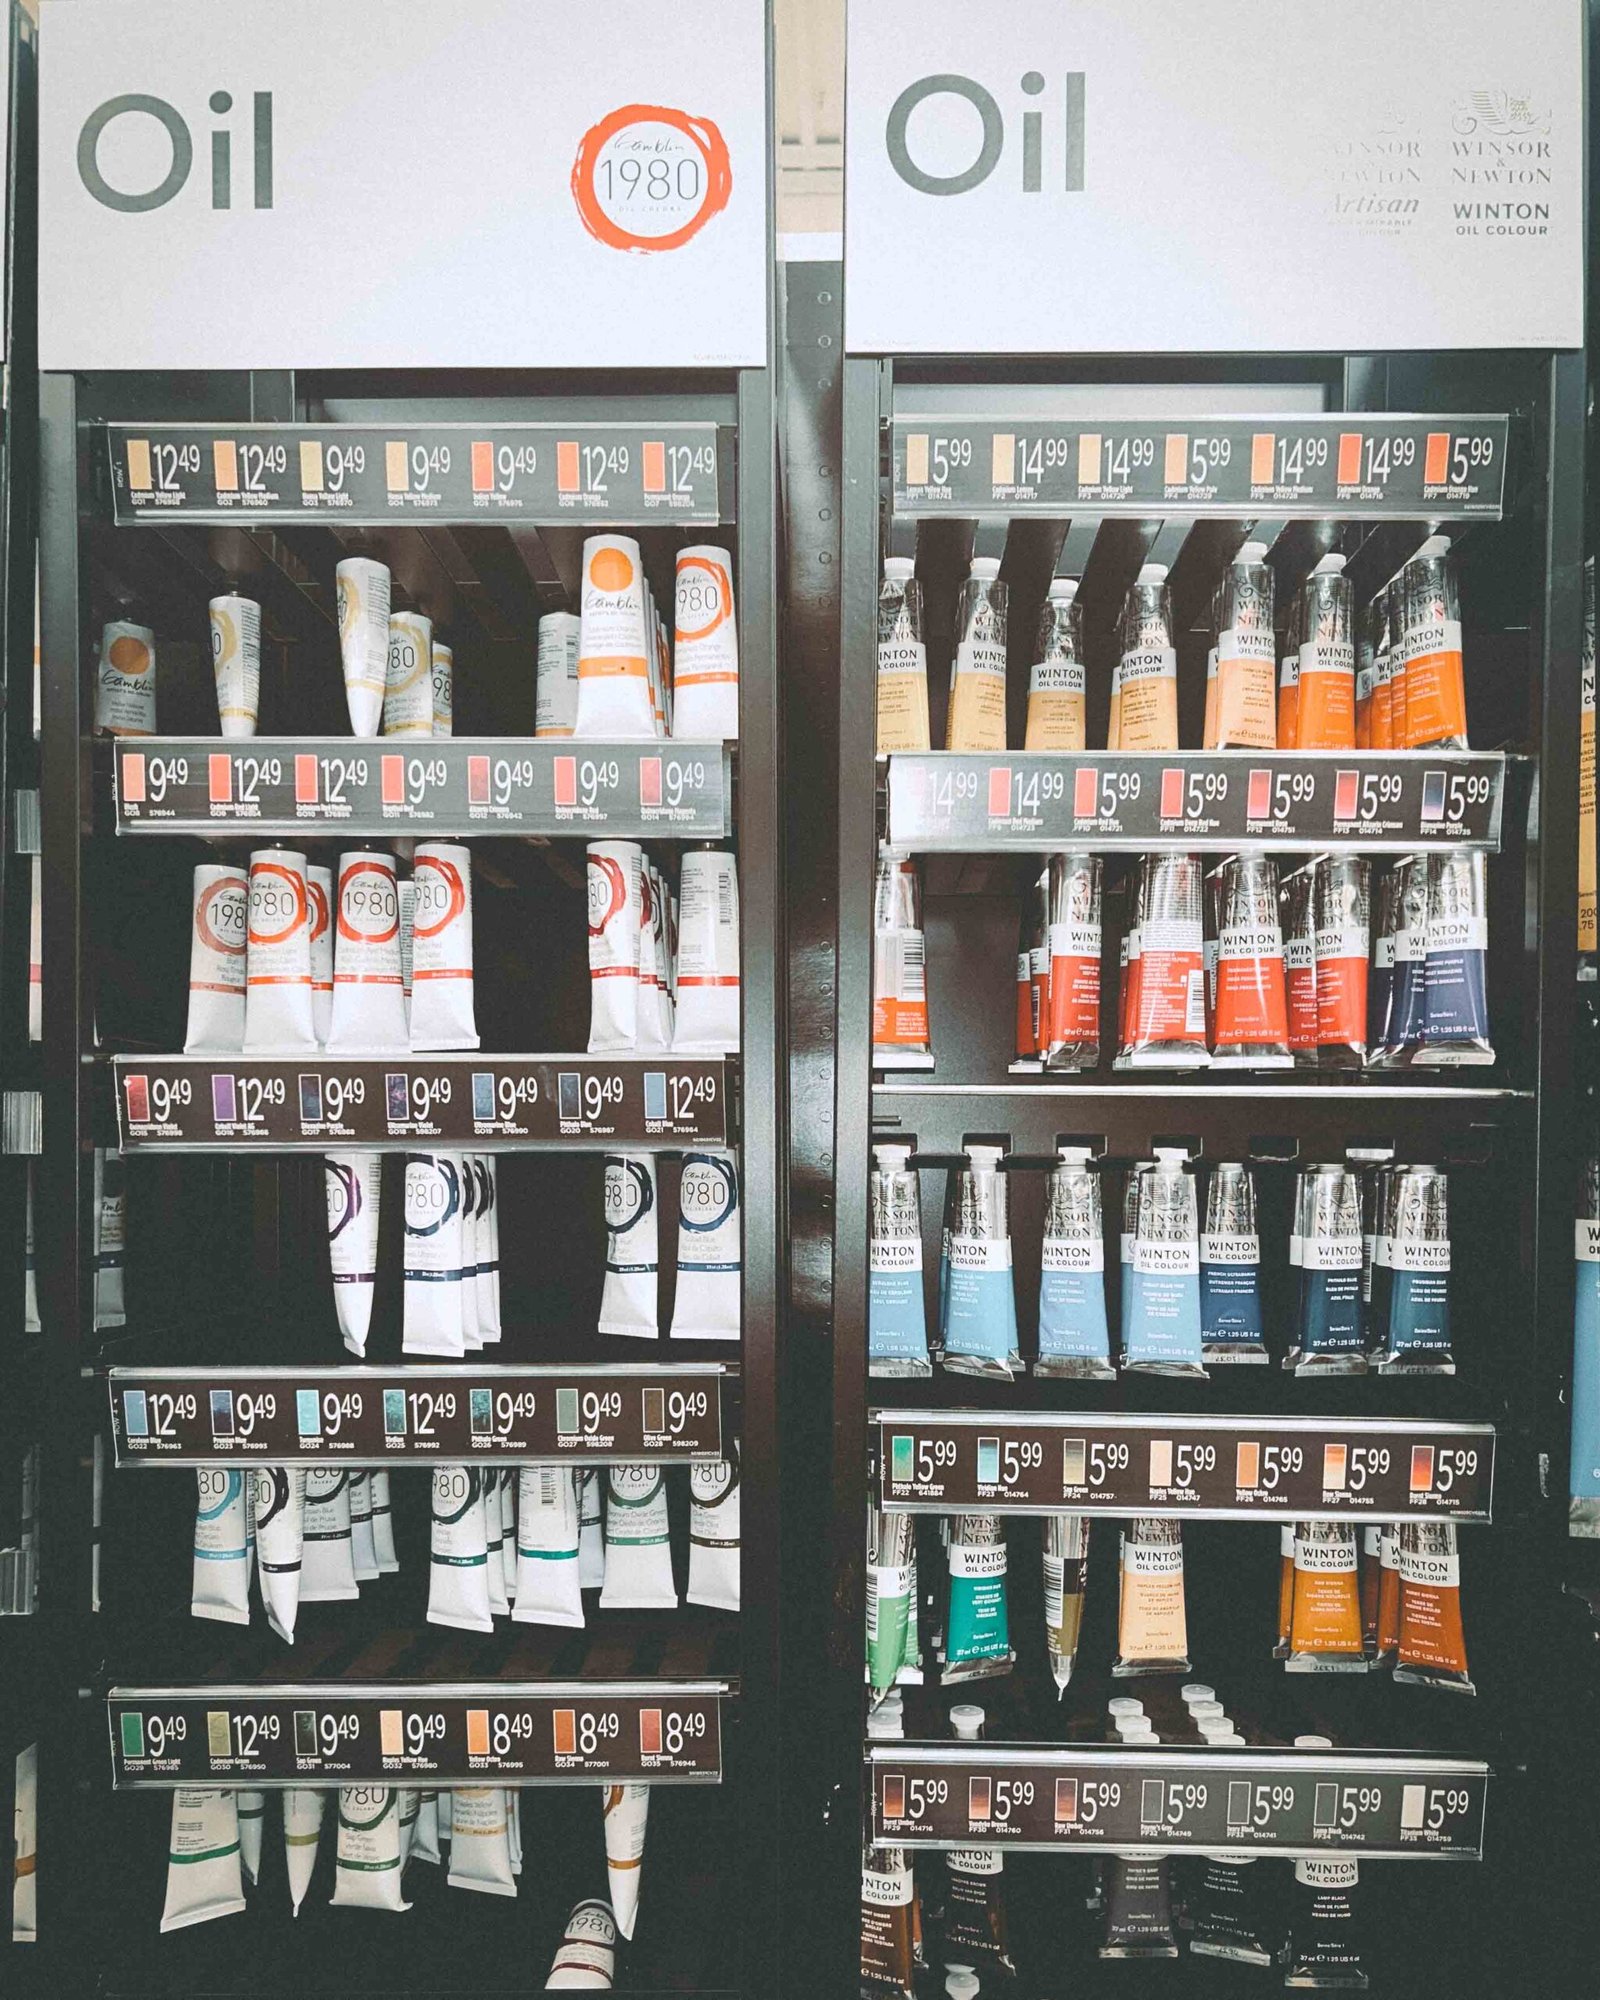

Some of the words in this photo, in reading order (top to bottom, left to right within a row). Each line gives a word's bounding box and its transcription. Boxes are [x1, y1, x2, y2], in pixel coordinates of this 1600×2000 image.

[885, 71, 1086, 196] Oil
[77, 91, 273, 213] Oil
[1452, 142, 1551, 158] WINSOR
[600, 158, 699, 201] 1980
[1452, 168, 1551, 184] NEWTON
[1453, 203, 1549, 219] WINTON
[1456, 225, 1479, 236] OIL
[1486, 225, 1548, 236] COLOUR
[677, 585, 718, 612] 980
[879, 649, 917, 661] INTON
[1317, 647, 1354, 659] WINTO
[1038, 668, 1083, 681] WINTON
[1055, 681, 1082, 689] COLOUR
[345, 891, 395, 917] 1980
[1427, 924, 1469, 937] INTON
[1223, 934, 1275, 947] WINTON
[1043, 1247, 1090, 1257] WINTON
[1208, 1242, 1257, 1251] WINTON
[1140, 1248, 1190, 1260] WINTON
[1058, 1259, 1090, 1267] COLOUR
[1140, 1261, 1155, 1269] OIL
[1135, 1550, 1182, 1562] WINTON
[1303, 1547, 1354, 1559] WINTON
[1320, 1560, 1354, 1568] COLOUR
[1400, 1557, 1448, 1573] WINTON
[1412, 1572, 1448, 1582] COLOUR
[960, 1860, 992, 1870] COLOUR
[1305, 1861, 1356, 1874] WINTON
[865, 1877, 901, 1892] NTON
[1324, 1875, 1355, 1883] COLOUR
[866, 1892, 900, 1901] COLOUR
[568, 1916, 614, 1941] 1980
